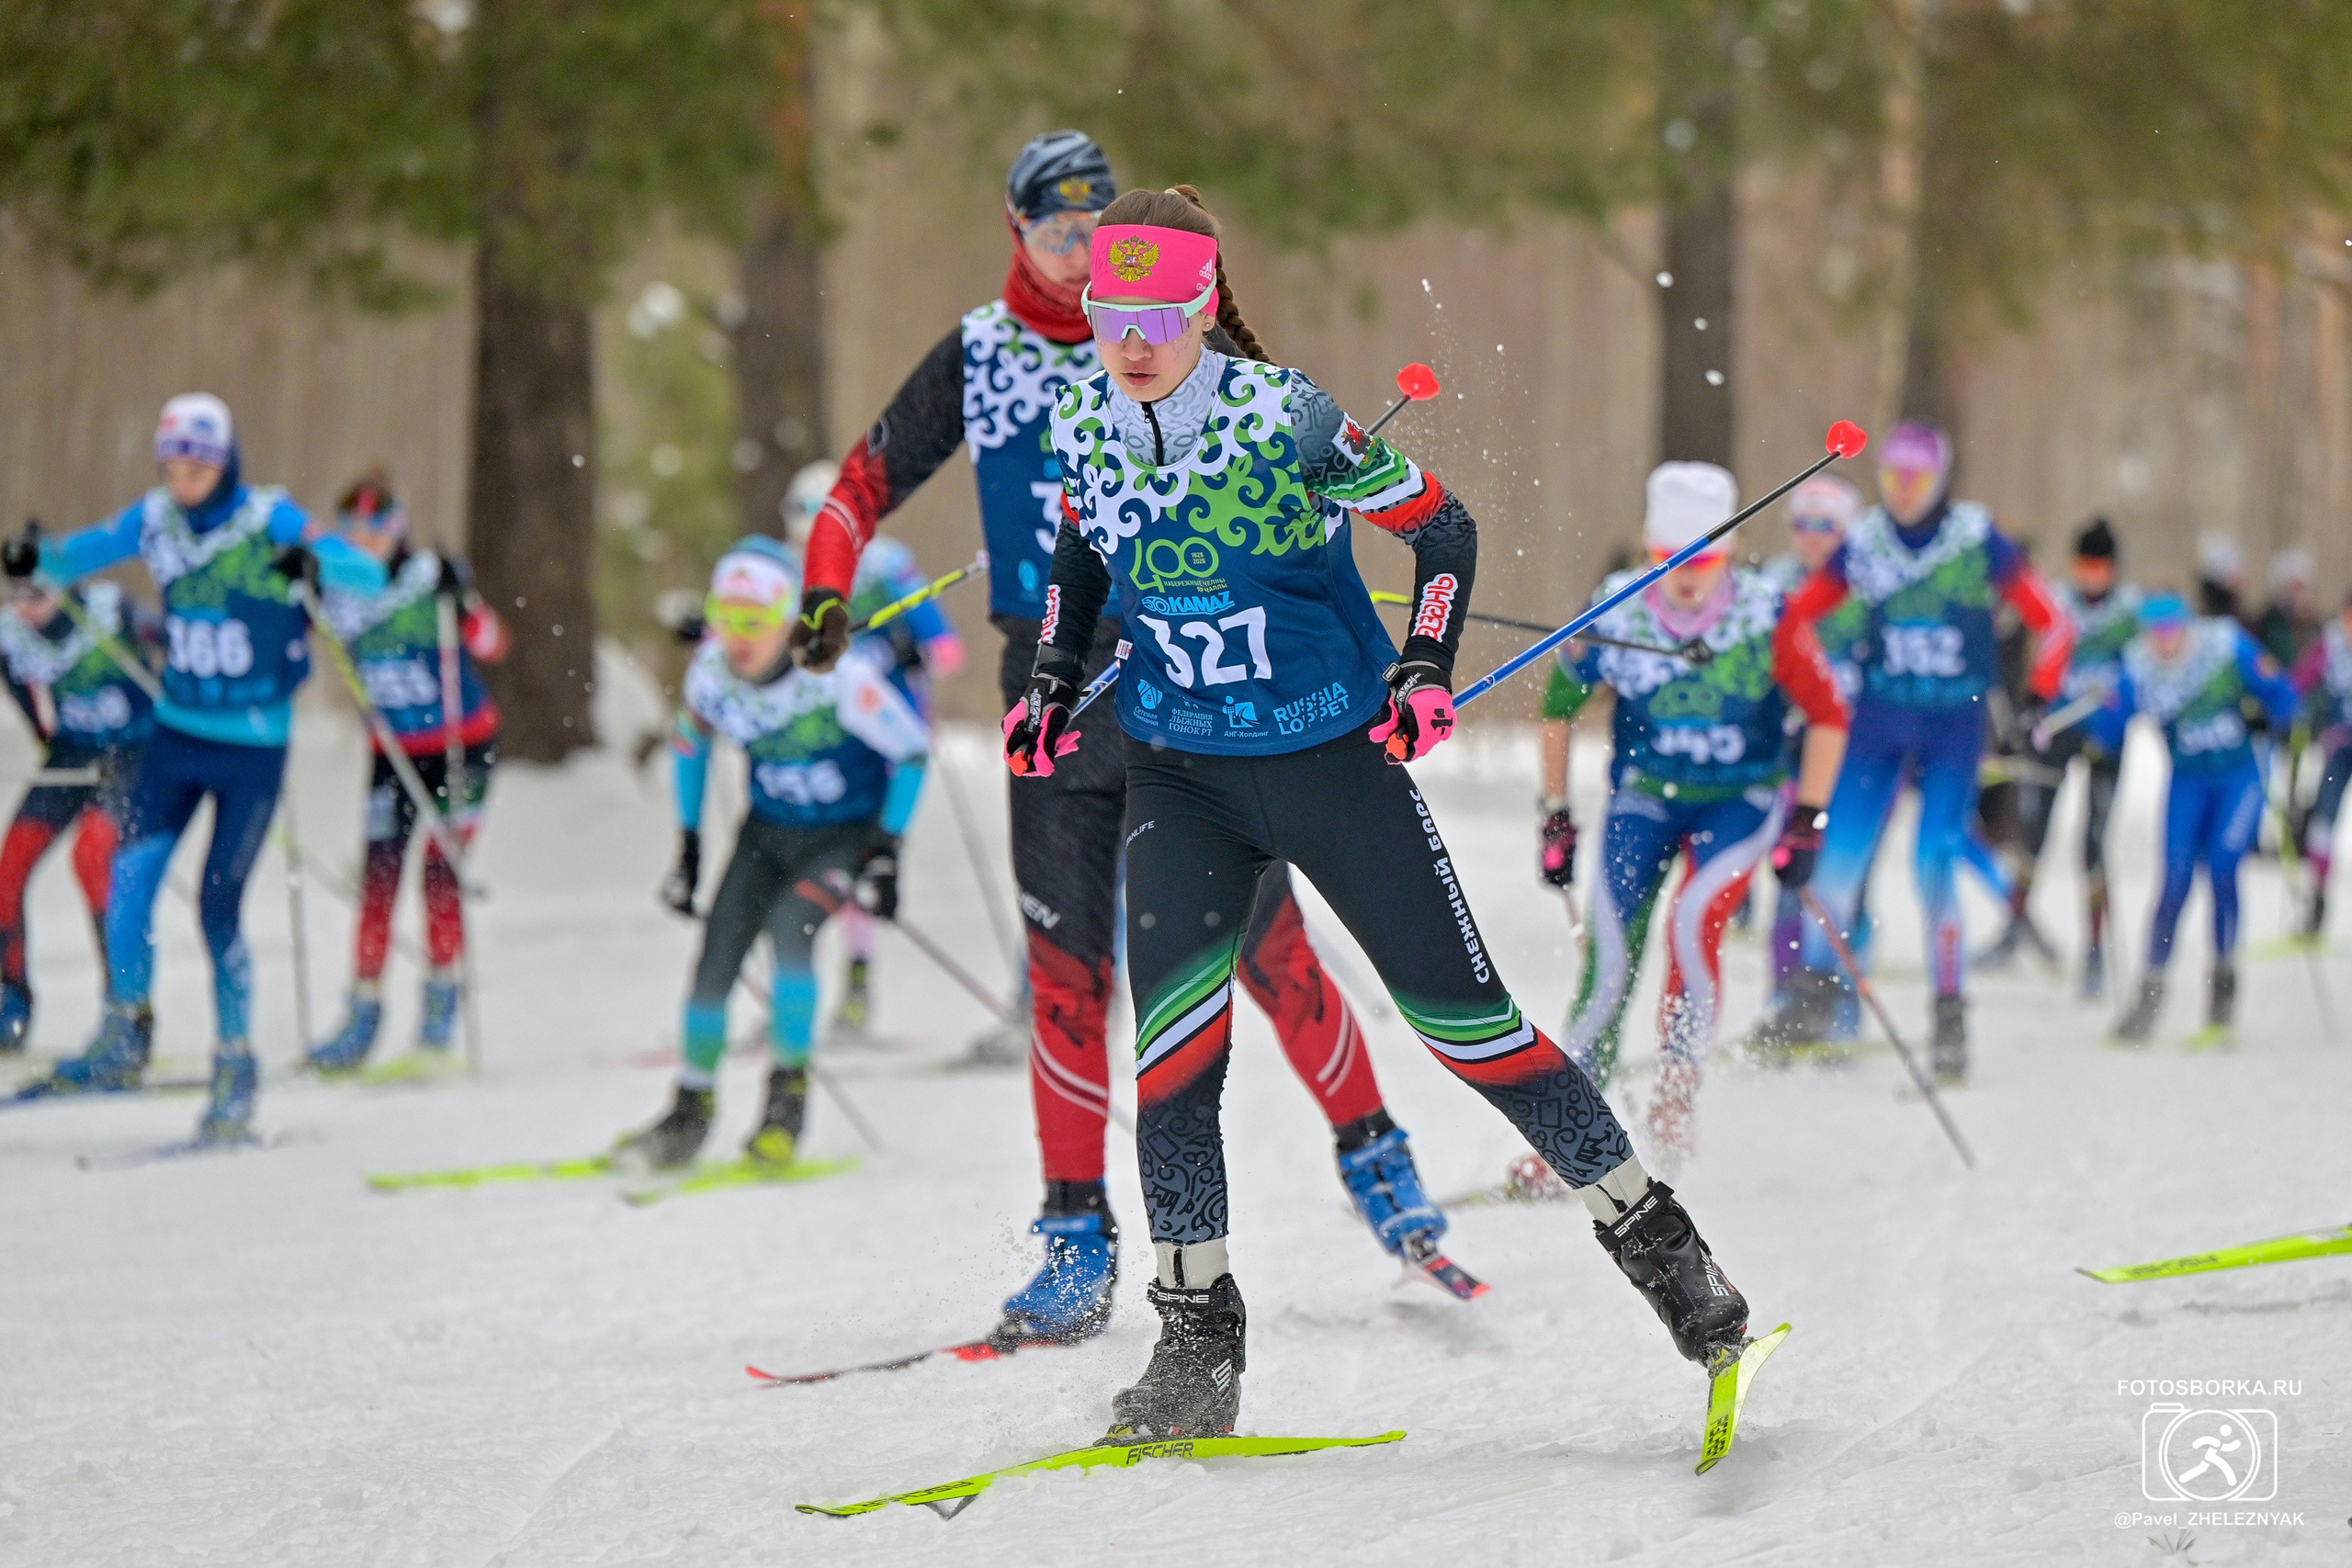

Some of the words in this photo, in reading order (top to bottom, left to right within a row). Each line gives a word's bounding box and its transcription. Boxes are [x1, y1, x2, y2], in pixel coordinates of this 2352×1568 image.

[1168, 591, 1231, 614] KAMAZ
[1136, 605, 1272, 689] 327
[1171, 708, 1213, 720] ФЕДЕРАЦИЯ
[1272, 682, 1348, 722] RUSSIA
[1278, 694, 1350, 735] LOPPET
[1169, 715, 1213, 728] ЛЫЖНЫХ
[1169, 722, 1200, 735] ГОНОК
[1201, 728, 1213, 736] РТ
[1409, 788, 1442, 852] БАРС
[1433, 856, 1490, 984] СНЕЖНЫЙ
[1613, 1195, 1658, 1238] SPINE
[1157, 1291, 1209, 1303] SPINE
[1125, 1441, 1194, 1465] FISCHER
